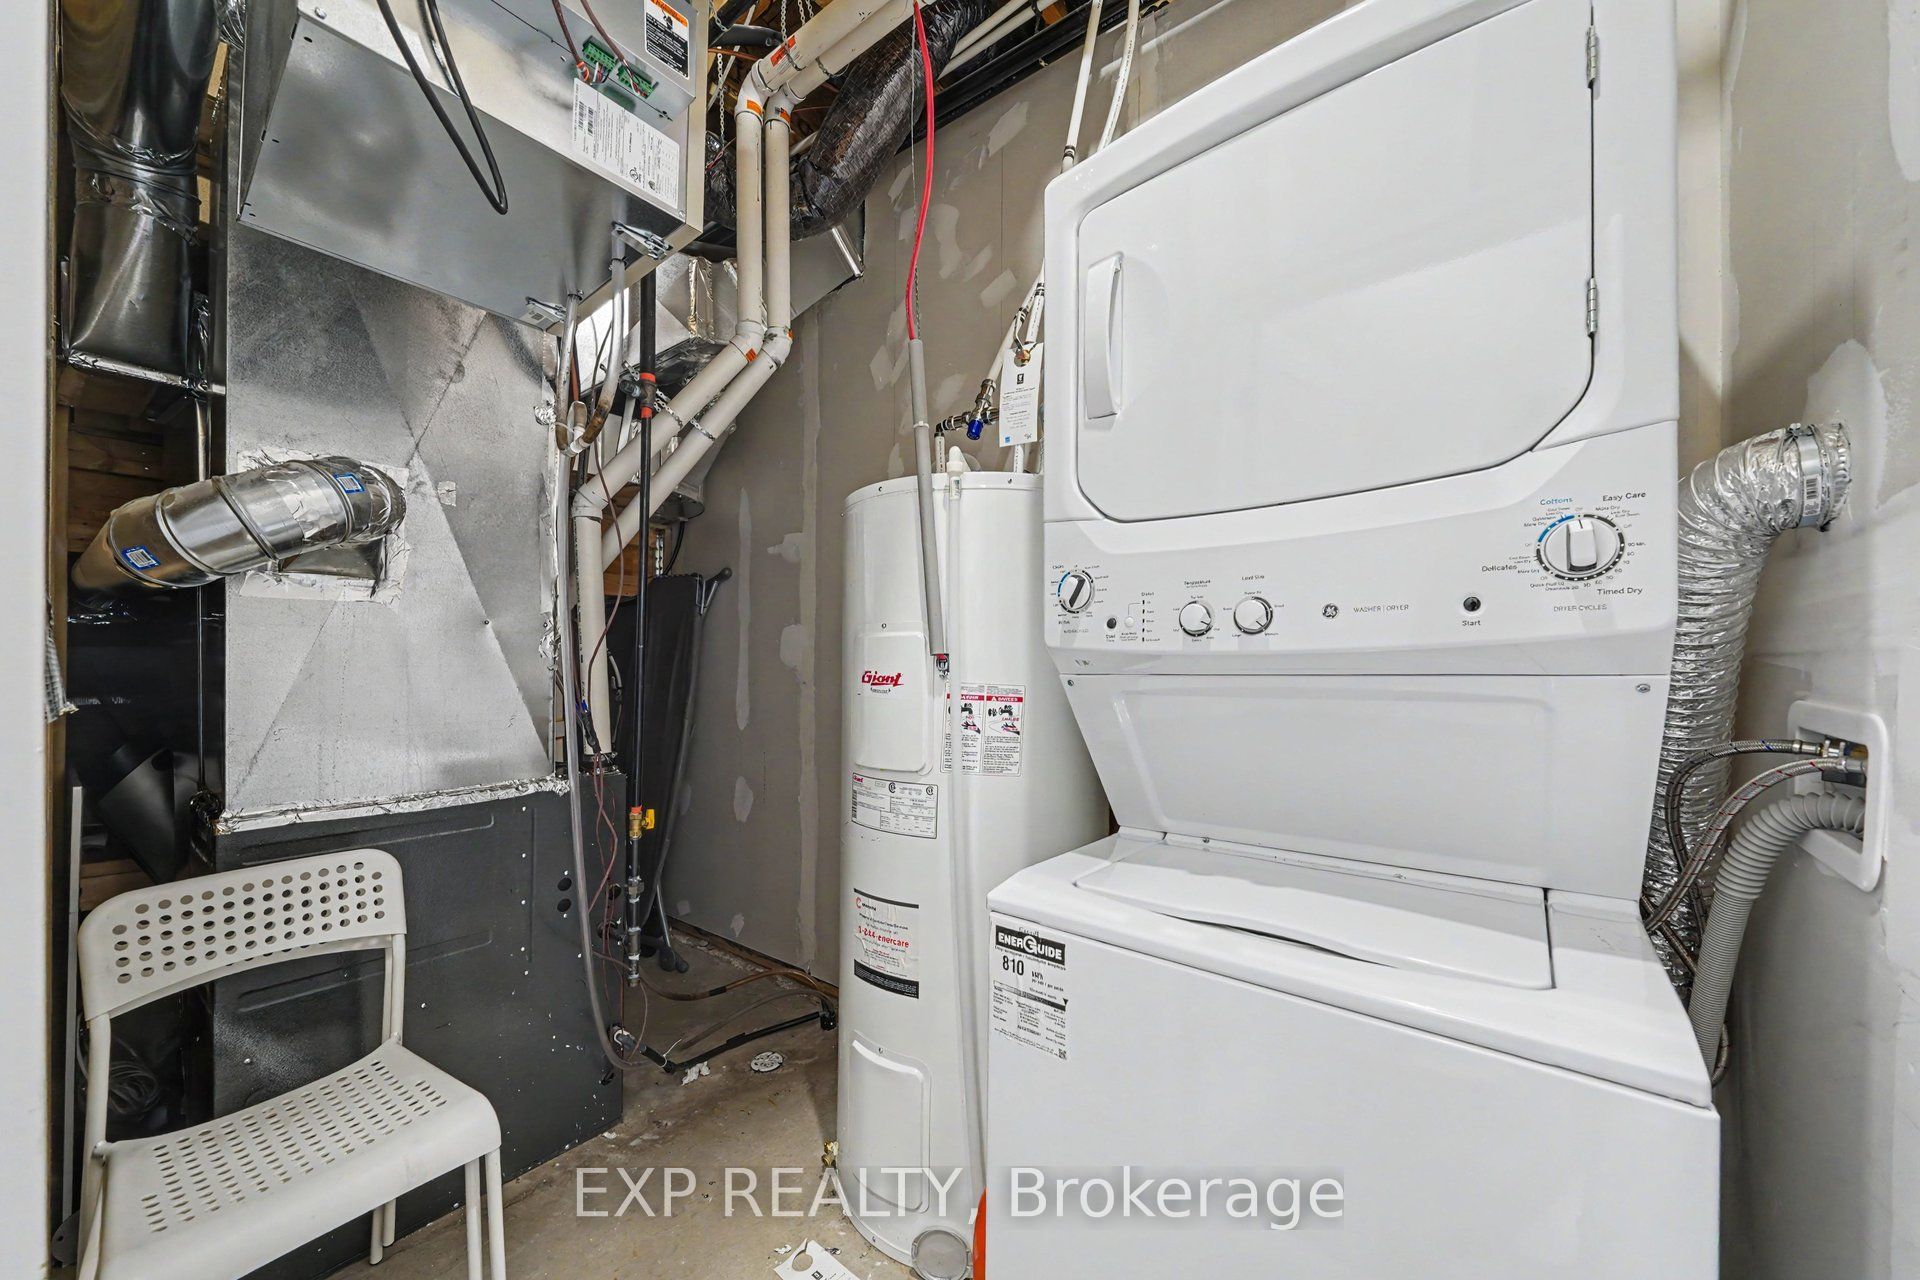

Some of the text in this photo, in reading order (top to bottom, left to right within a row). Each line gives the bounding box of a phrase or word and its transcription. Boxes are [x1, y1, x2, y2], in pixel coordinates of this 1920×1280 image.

[1540, 497, 1573, 506] Cottons
[1602, 494, 1623, 502] Easy
[1481, 564, 1518, 572] Delicates
[1626, 587, 1643, 595] Dry
[1353, 603, 1410, 613] WASHER DRYER
[1553, 603, 1608, 613] DRYER CYCLES
[862, 670, 904, 687] Giant
[1002, 955, 1025, 976] 810
